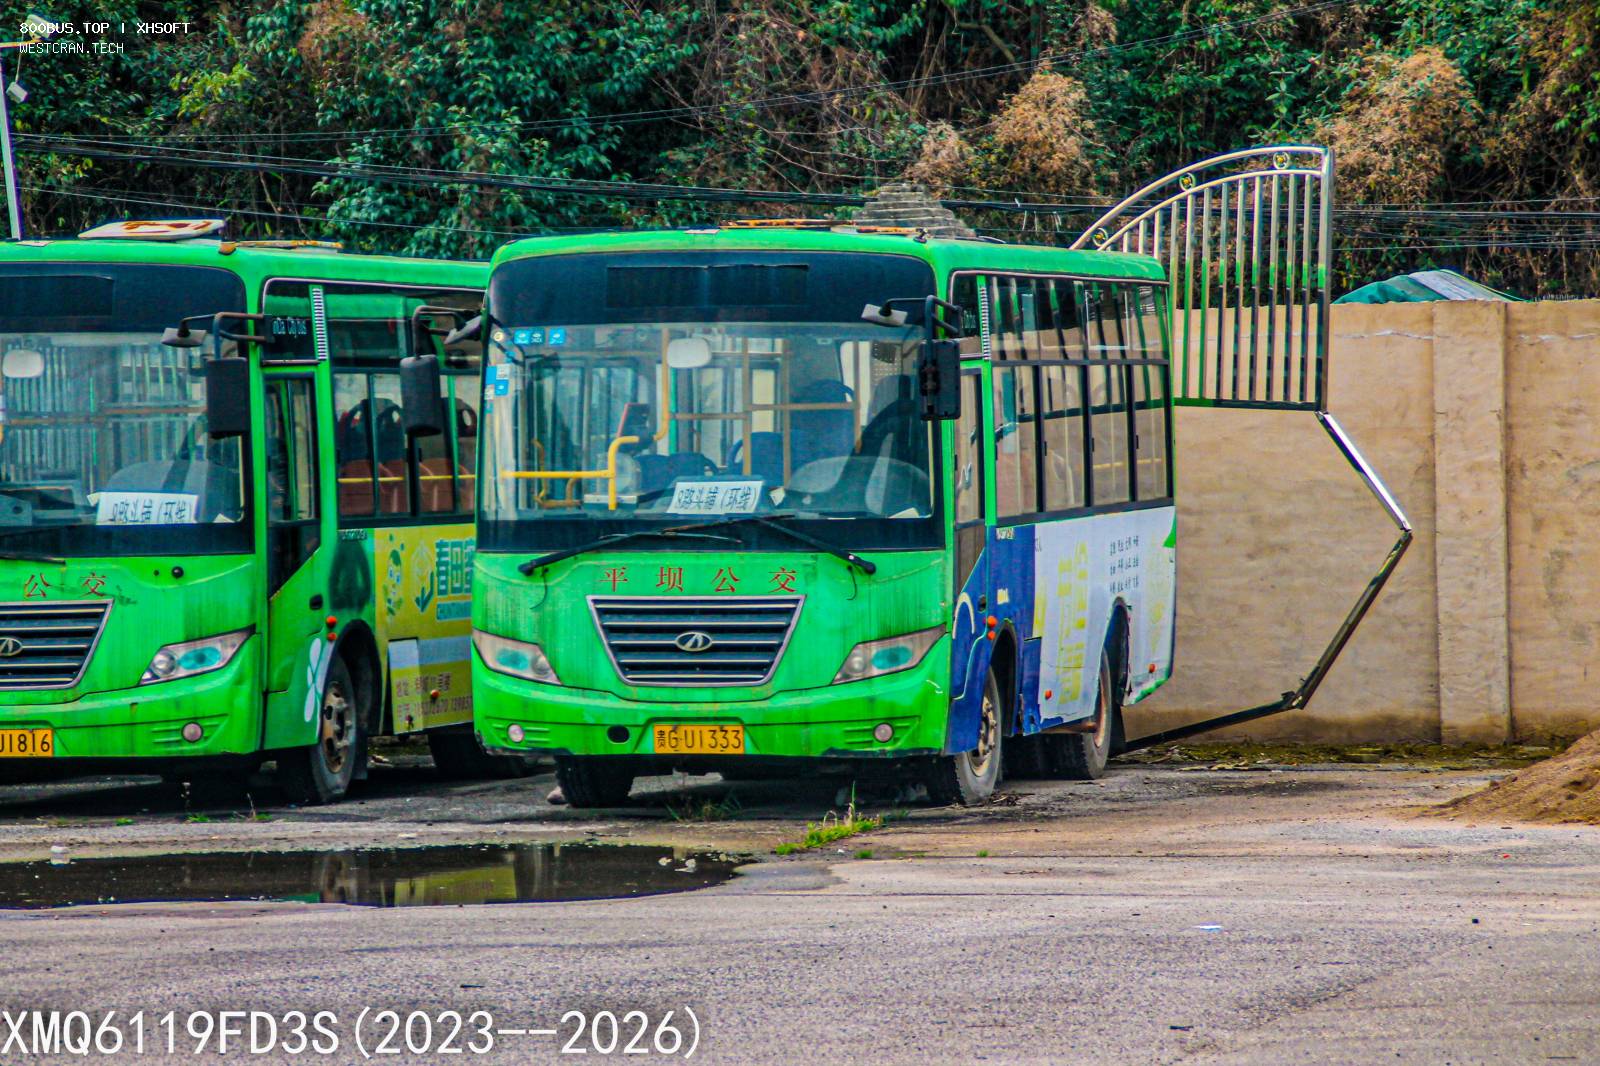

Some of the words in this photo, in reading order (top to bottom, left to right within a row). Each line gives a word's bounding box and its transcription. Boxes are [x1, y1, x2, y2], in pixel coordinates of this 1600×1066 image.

[23, 571, 107, 598] 公交
[600, 566, 798, 593] 平坝公交
